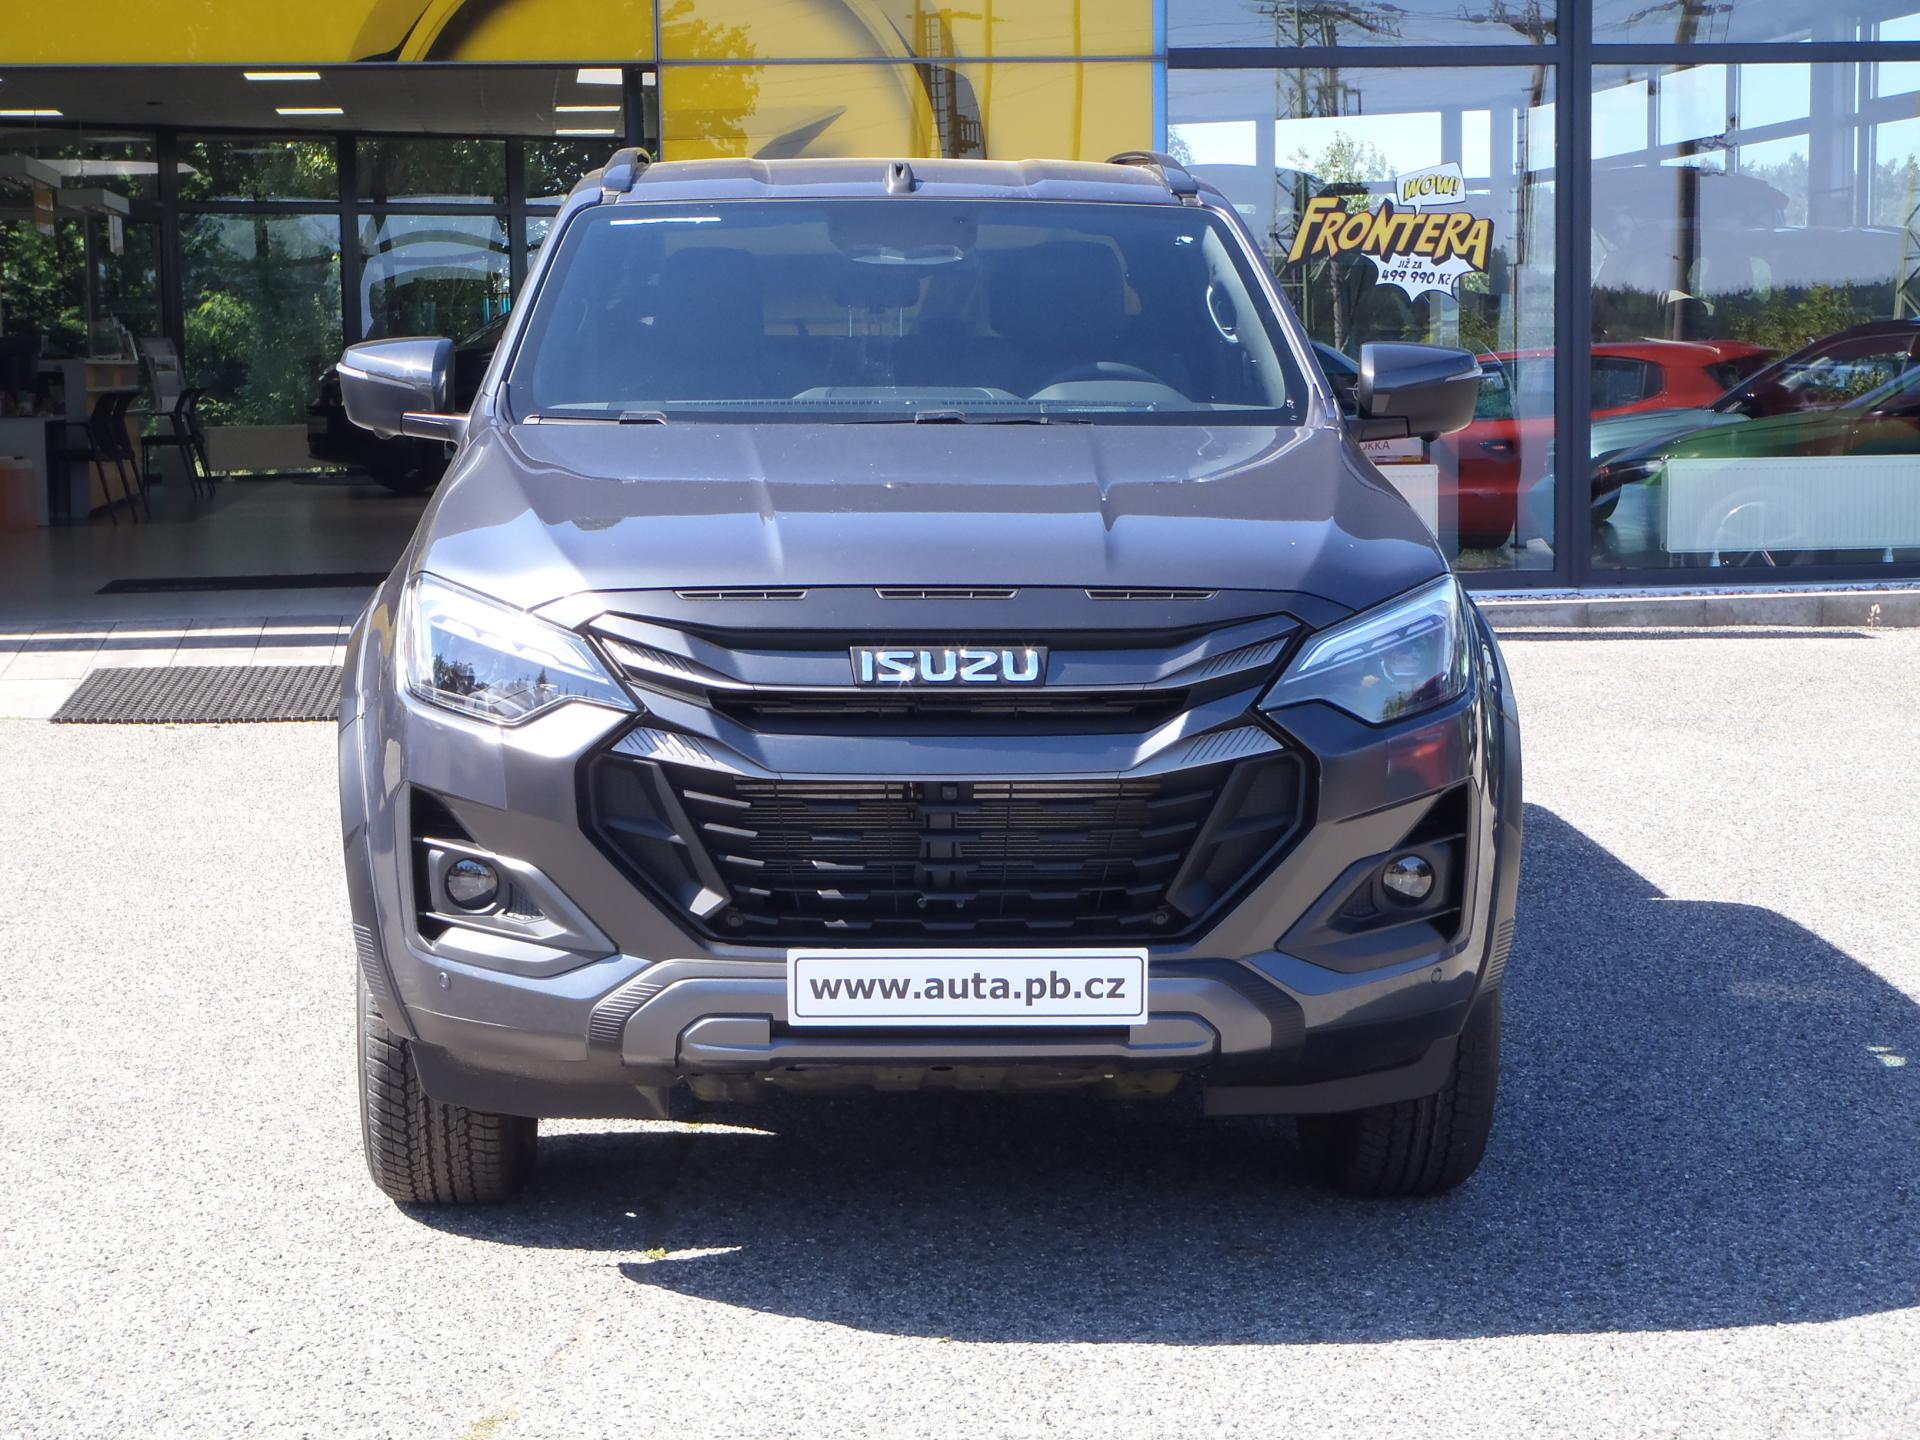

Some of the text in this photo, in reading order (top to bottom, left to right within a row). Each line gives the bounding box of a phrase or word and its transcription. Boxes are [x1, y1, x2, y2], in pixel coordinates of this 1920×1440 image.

[1403, 174, 1460, 201] WOW!
[1287, 196, 1494, 272] FRONTERA
[1382, 269, 1452, 286] 499 990 Kč
[1398, 258, 1423, 269] JIŽ ZA
[861, 650, 1039, 682] ISUZU
[809, 971, 1126, 1006] www.auta.pb.cz
